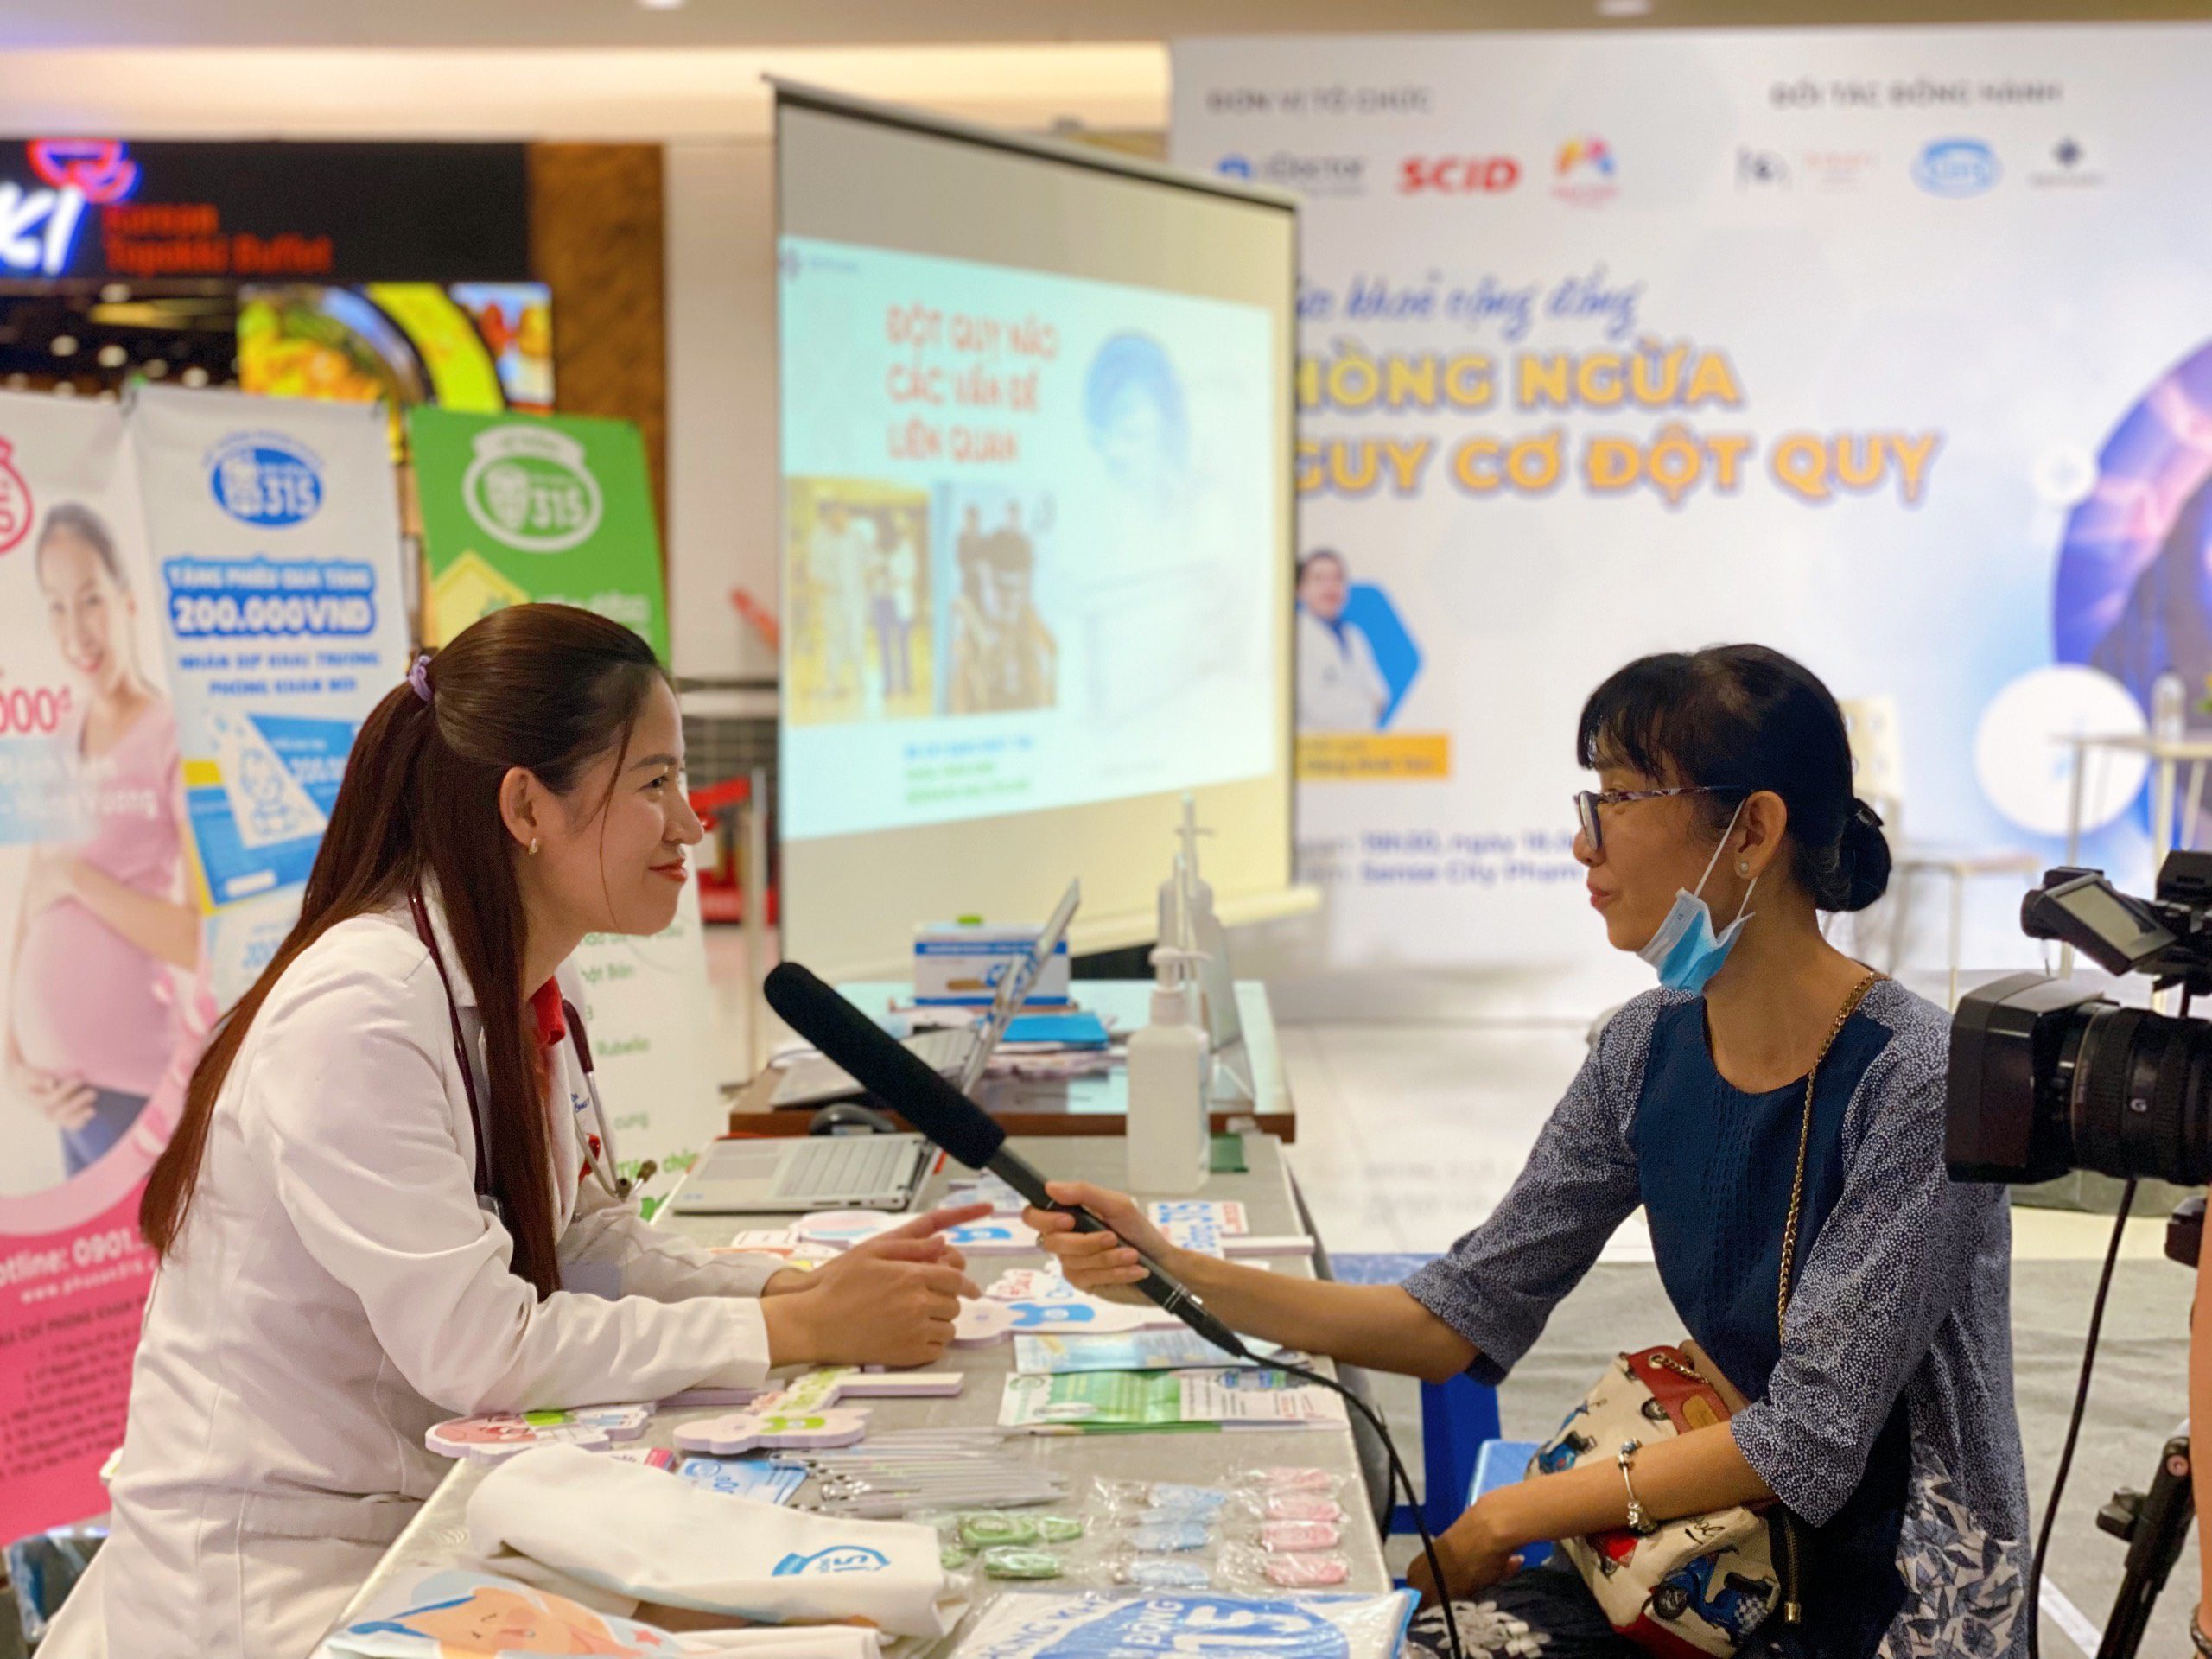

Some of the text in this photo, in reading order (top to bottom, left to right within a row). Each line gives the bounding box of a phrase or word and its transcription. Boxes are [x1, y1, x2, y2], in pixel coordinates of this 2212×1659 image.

[1395, 153, 1523, 195] SCID
[1516, 335, 1747, 411] NGỪA
[1449, 424, 1567, 499] CƠ
[1580, 419, 1756, 509] ĐỘT
